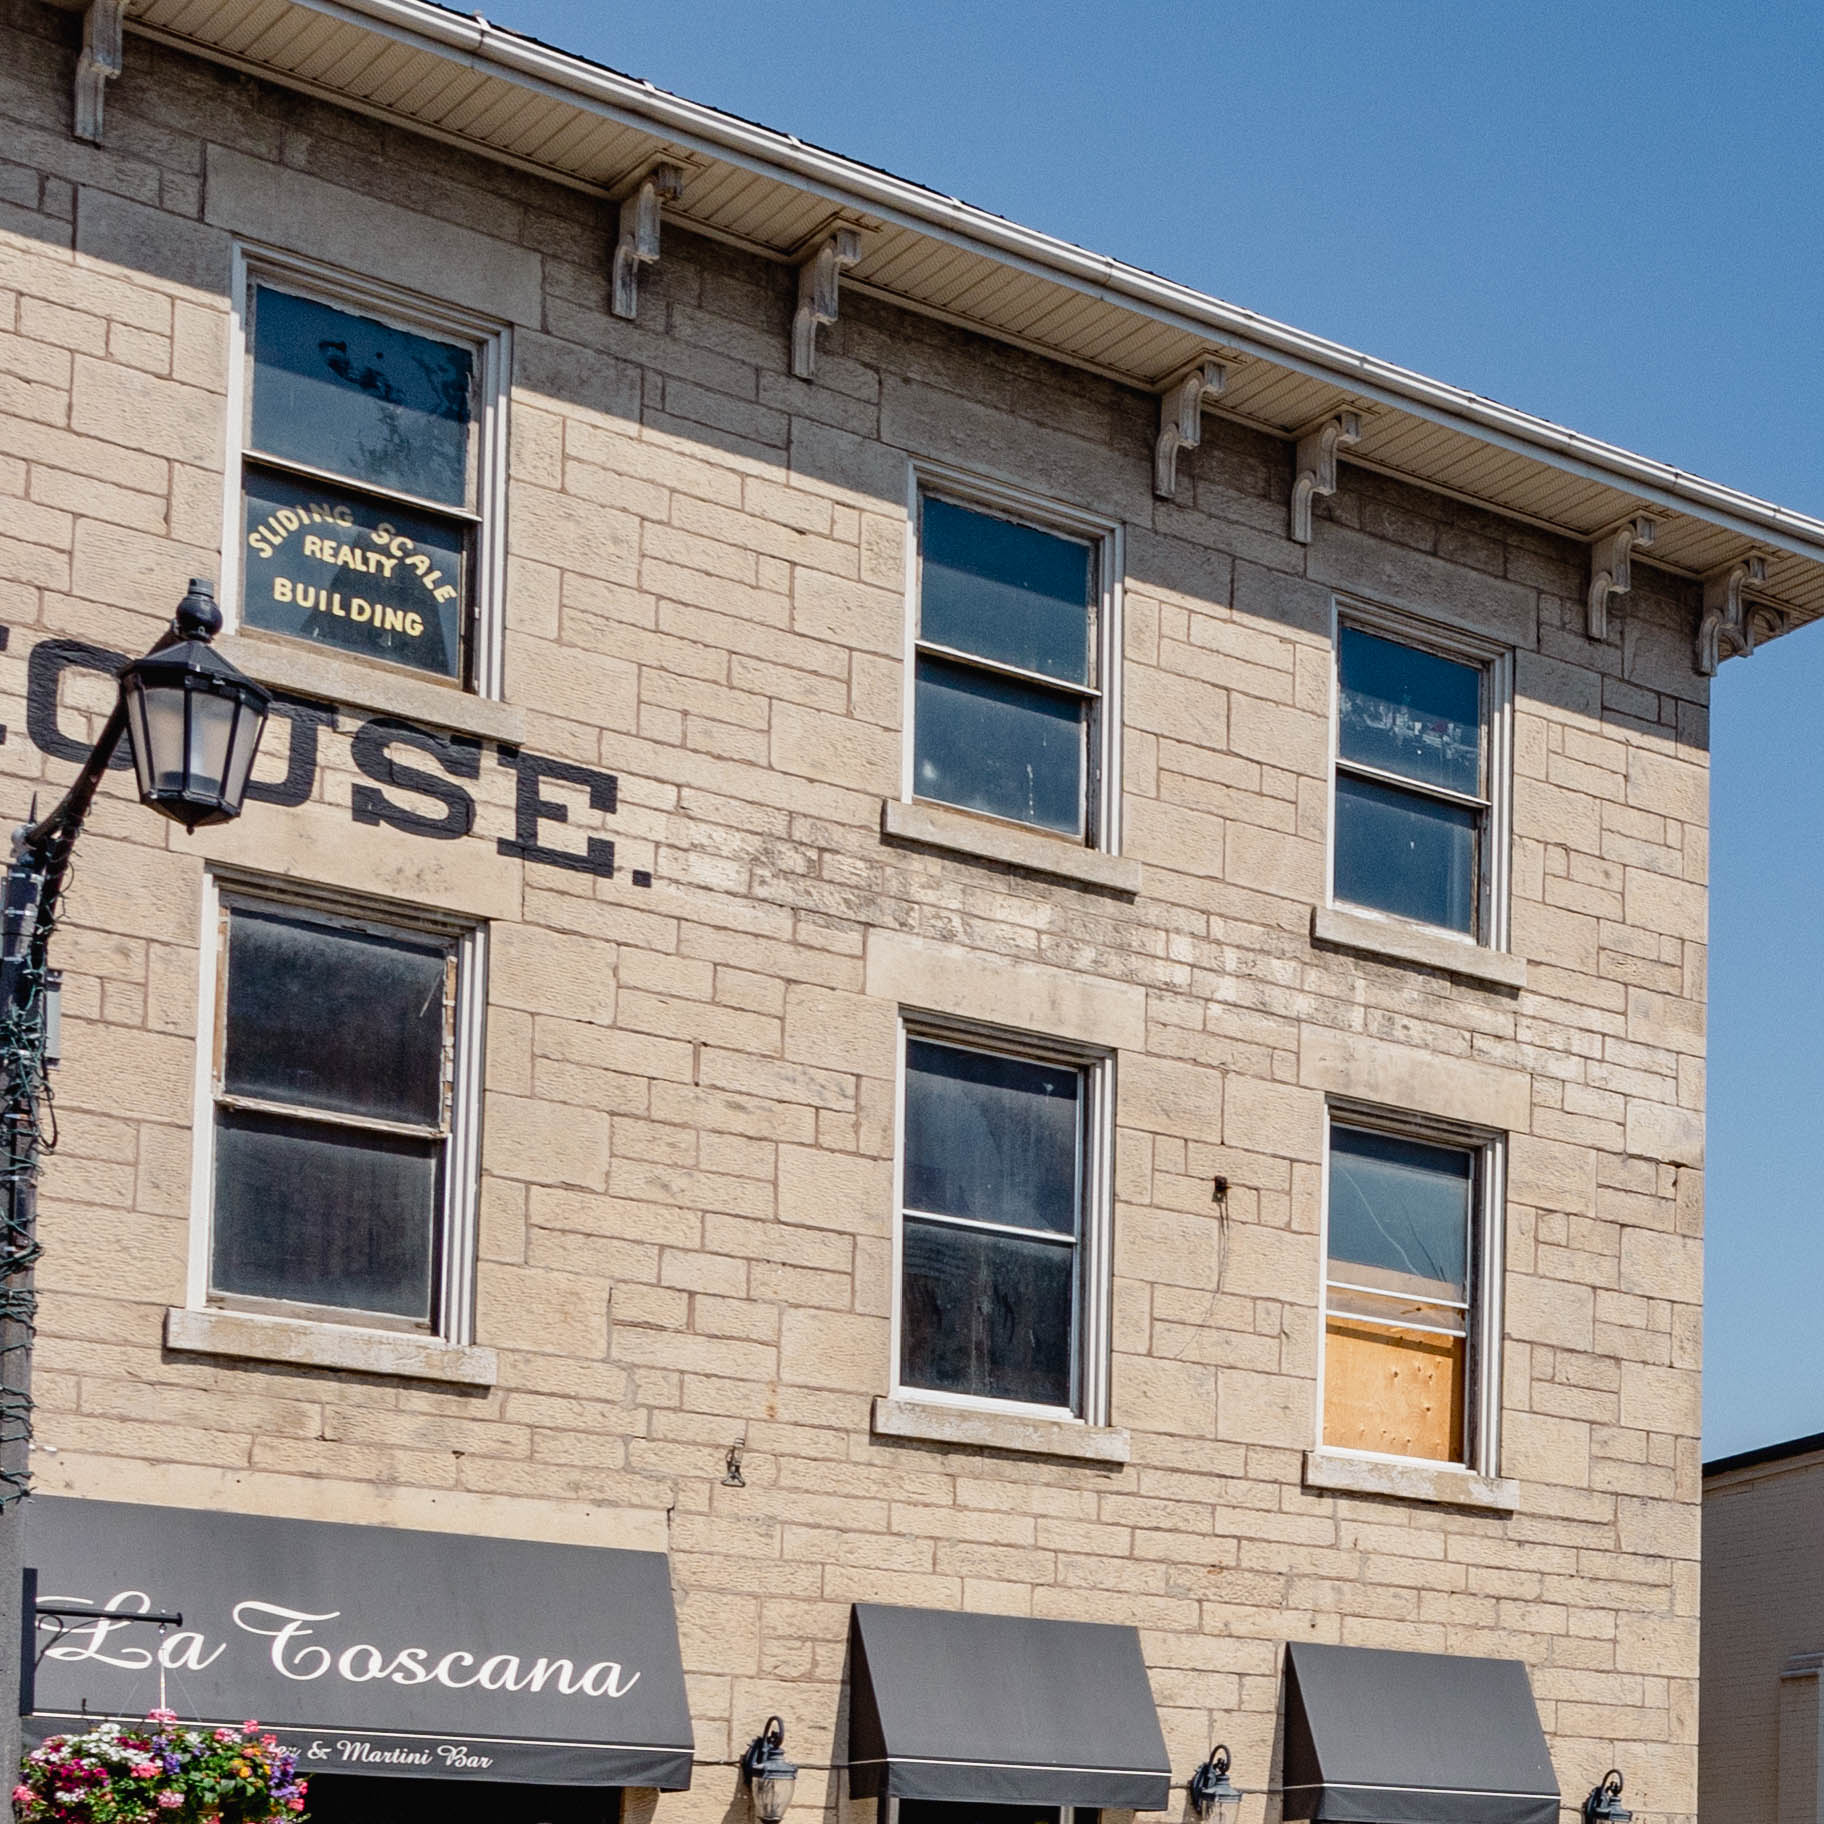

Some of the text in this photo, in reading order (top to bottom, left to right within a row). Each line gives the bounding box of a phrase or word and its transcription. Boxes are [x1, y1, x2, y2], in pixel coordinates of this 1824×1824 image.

[248, 503, 458, 604] SLIDING SCALE
[303, 534, 398, 577] REALTY
[273, 576, 424, 636] BUILDING
[36, 1591, 641, 1698] La Toscana
[308, 1740, 332, 1760] &
[337, 1740, 432, 1765] Martini
[437, 1745, 493, 1769] Bar
